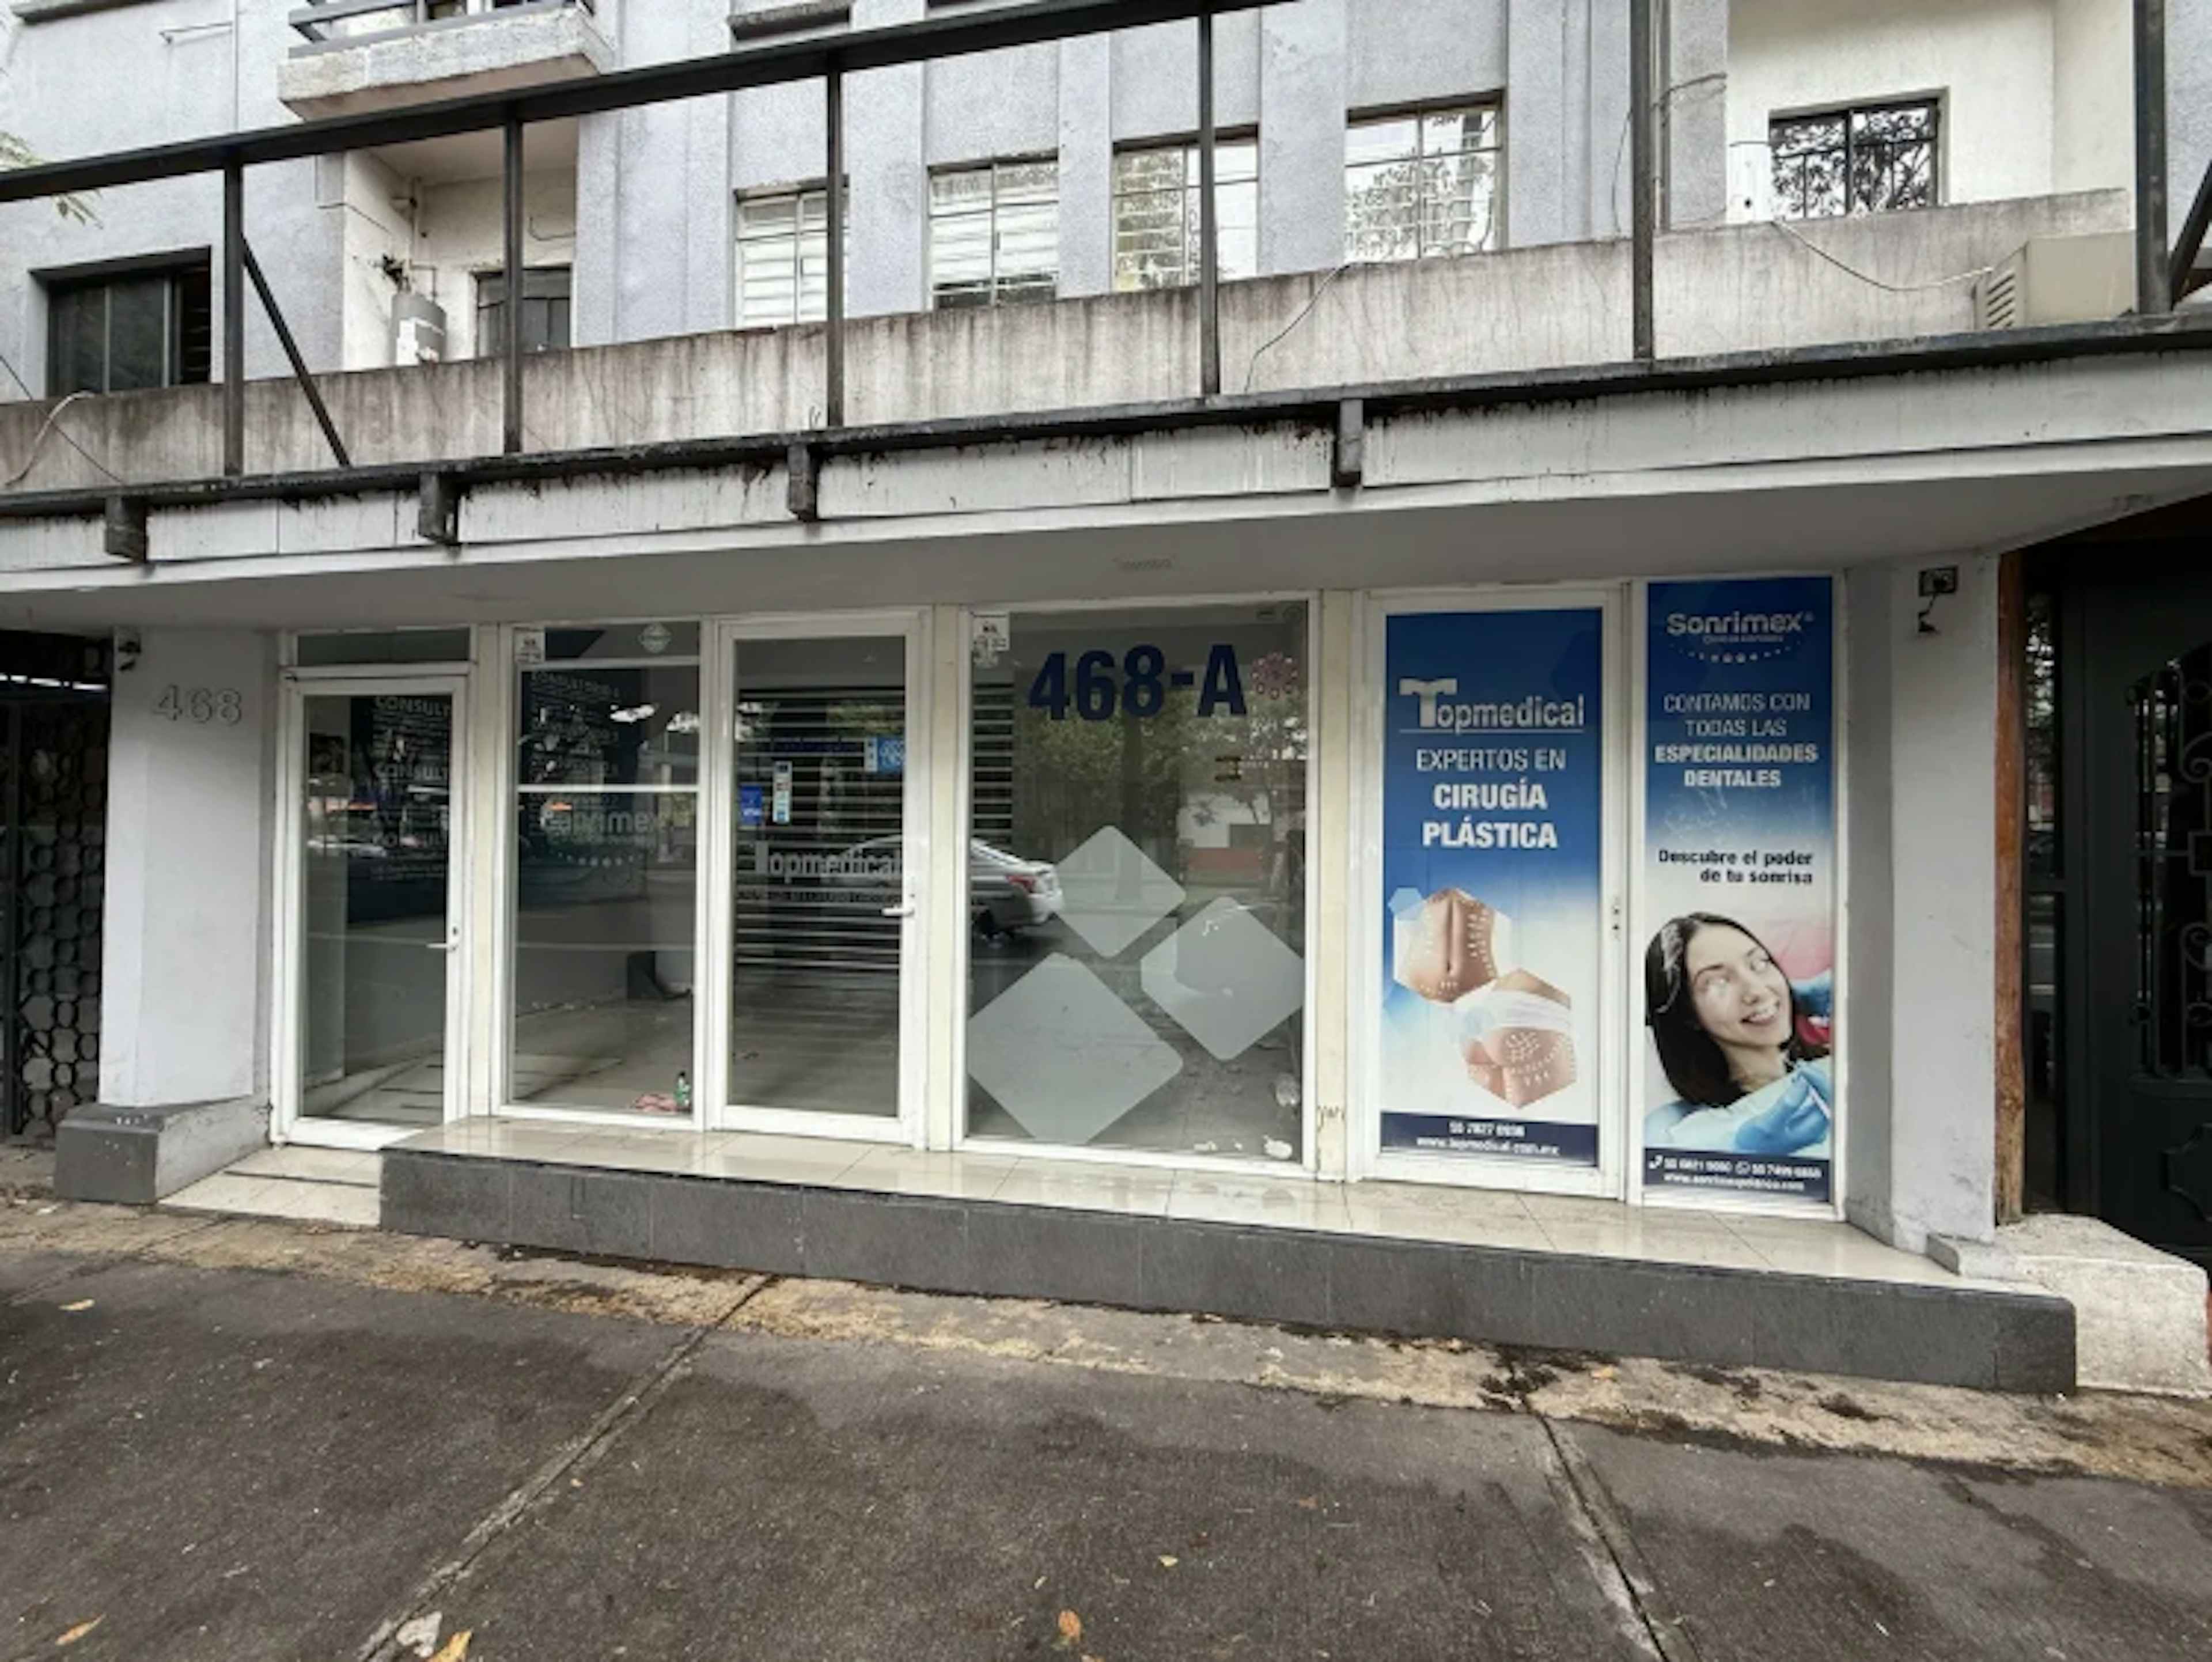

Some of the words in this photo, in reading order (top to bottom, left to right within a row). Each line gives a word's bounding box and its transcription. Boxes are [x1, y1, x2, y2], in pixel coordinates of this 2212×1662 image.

[1666, 609, 1804, 635] Sonrimex
[1028, 645, 1247, 721] 468-A
[152, 684, 242, 726] 468
[1399, 678, 1584, 734] Topmedical
[1664, 693, 1765, 712] CONTAMOS
[1769, 693, 1810, 710] CON
[1685, 720, 1746, 737] TODAS
[1752, 718, 1787, 736] LAS
[1416, 748, 1527, 771] EXPERTOS
[1535, 748, 1566, 769] EN
[1654, 744, 1818, 763] ESPECIALIDADES
[1684, 769, 1781, 788] DENTALES
[1433, 779, 1547, 810] CIRUGÍA
[1423, 816, 1557, 848] PLÁSTICA
[1658, 849, 1736, 865] Descubre
[1743, 850, 1758, 865] el
[1764, 850, 1812, 869] poder
[1700, 868, 1722, 883] de
[1726, 869, 1744, 883] tu
[1749, 869, 1813, 884] sonrisa
